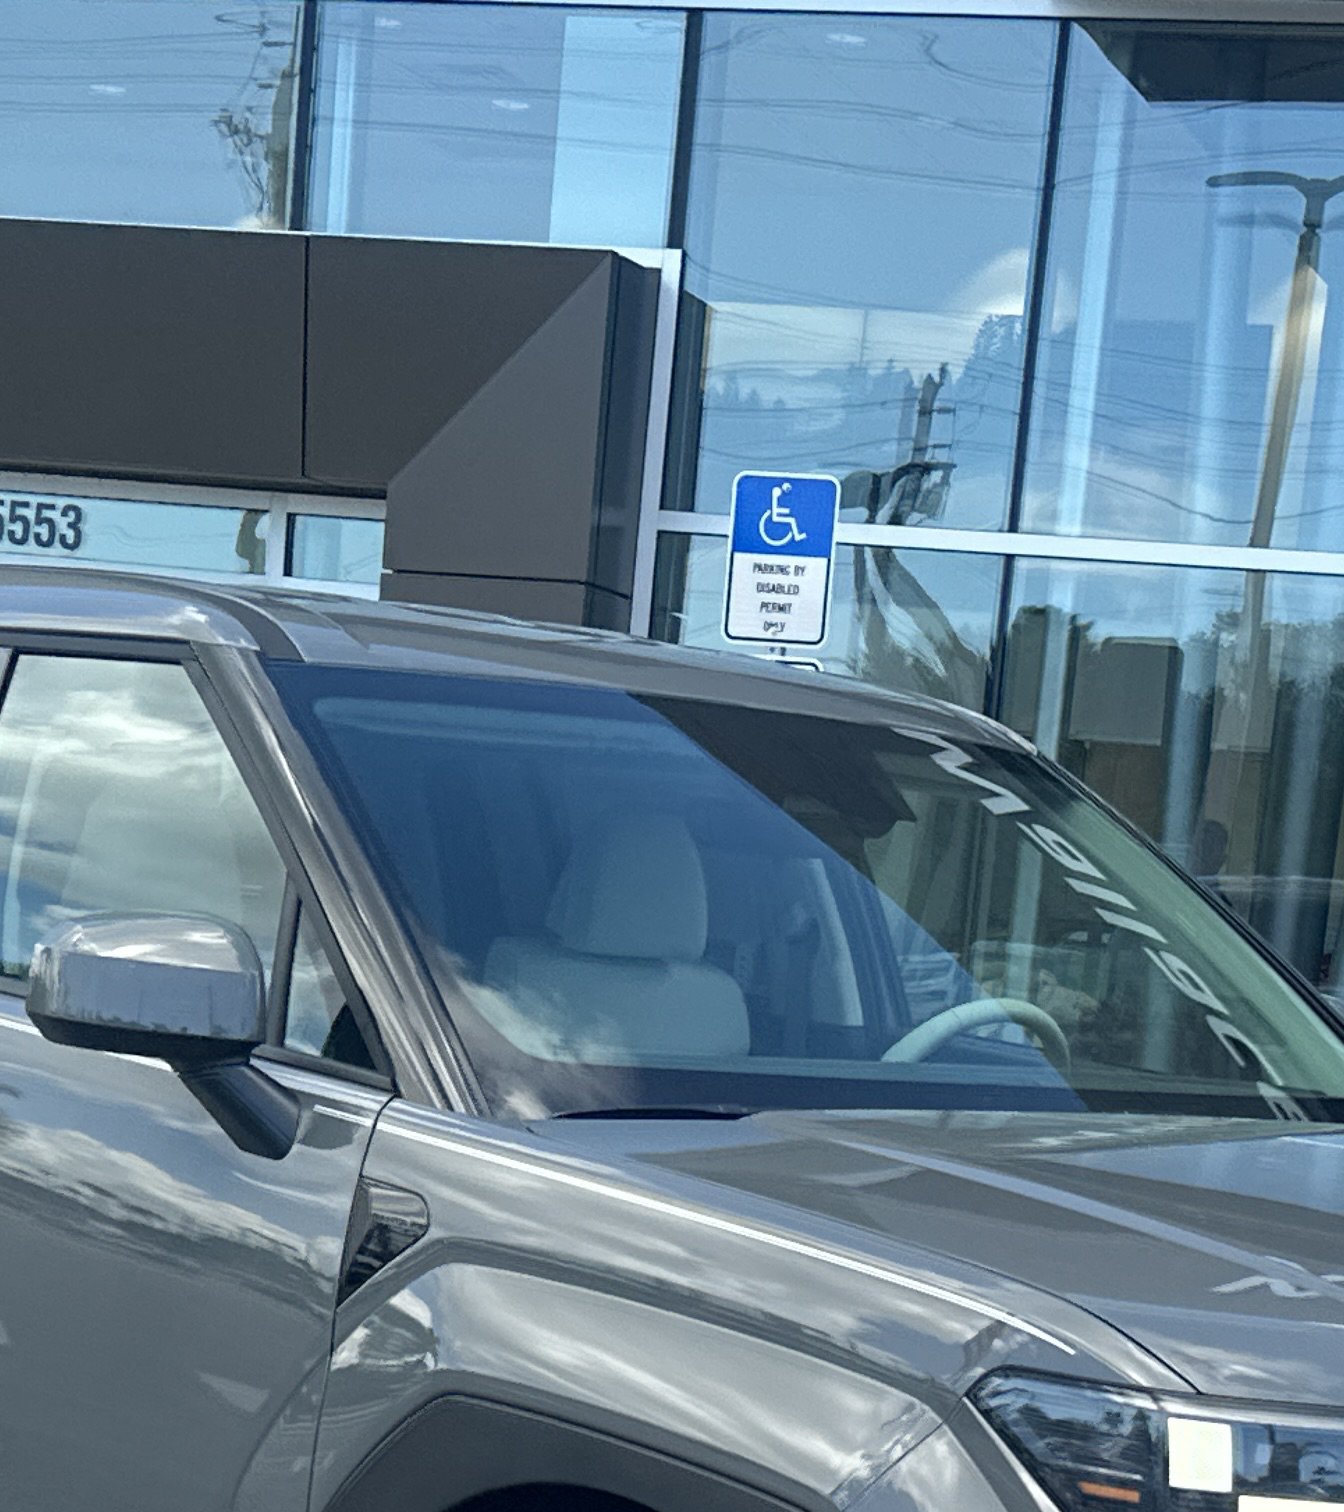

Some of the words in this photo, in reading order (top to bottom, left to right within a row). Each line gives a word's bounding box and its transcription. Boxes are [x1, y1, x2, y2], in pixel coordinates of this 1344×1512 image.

[753, 562, 791, 576] PARKING
[794, 565, 806, 576] BY
[756, 581, 800, 595] DISABLED
[760, 601, 792, 614] PERMIT
